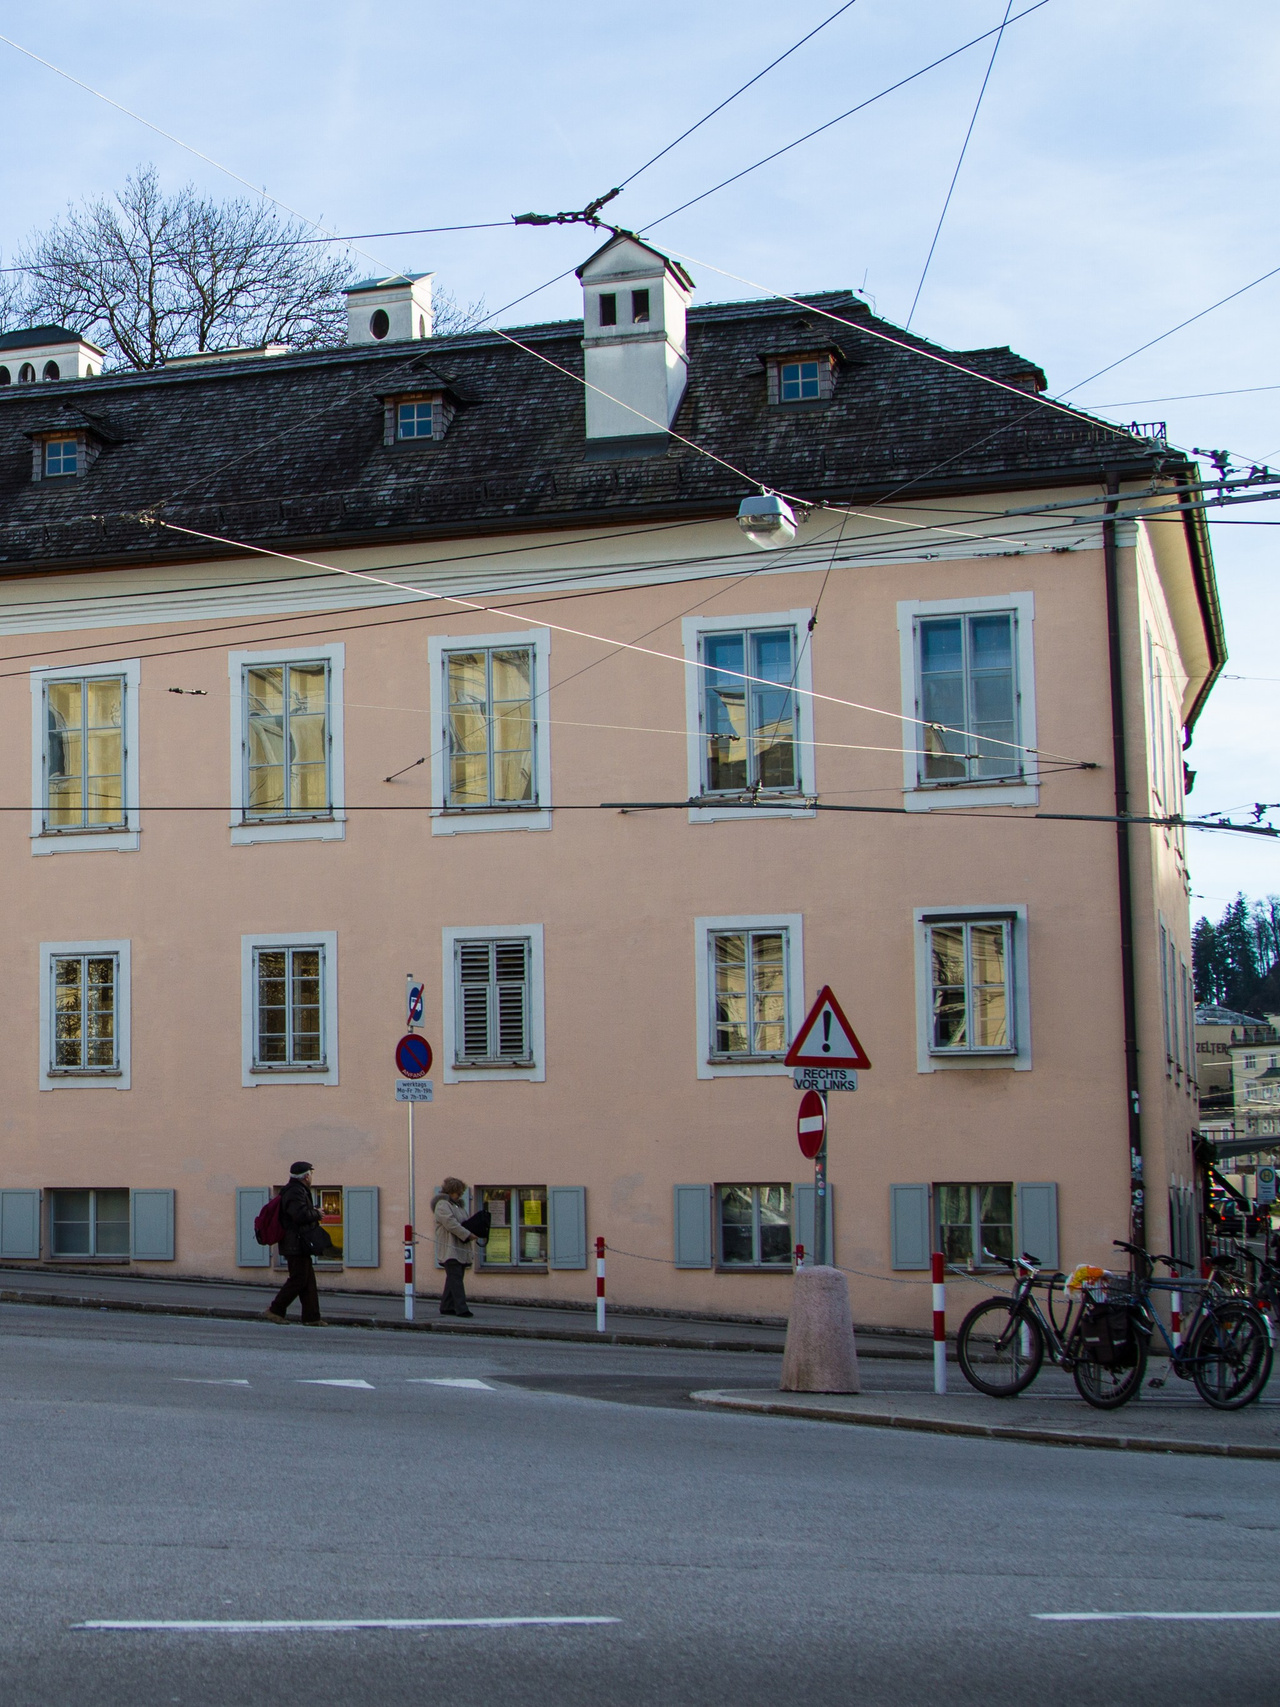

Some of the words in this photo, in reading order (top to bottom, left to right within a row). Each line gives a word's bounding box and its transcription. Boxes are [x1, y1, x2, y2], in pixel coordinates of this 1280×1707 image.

[402, 1069, 426, 1078] ANFANG
[803, 1068, 847, 1080] RECHTS
[795, 1079, 819, 1090] VOR
[823, 1080, 855, 1090] LINKS
